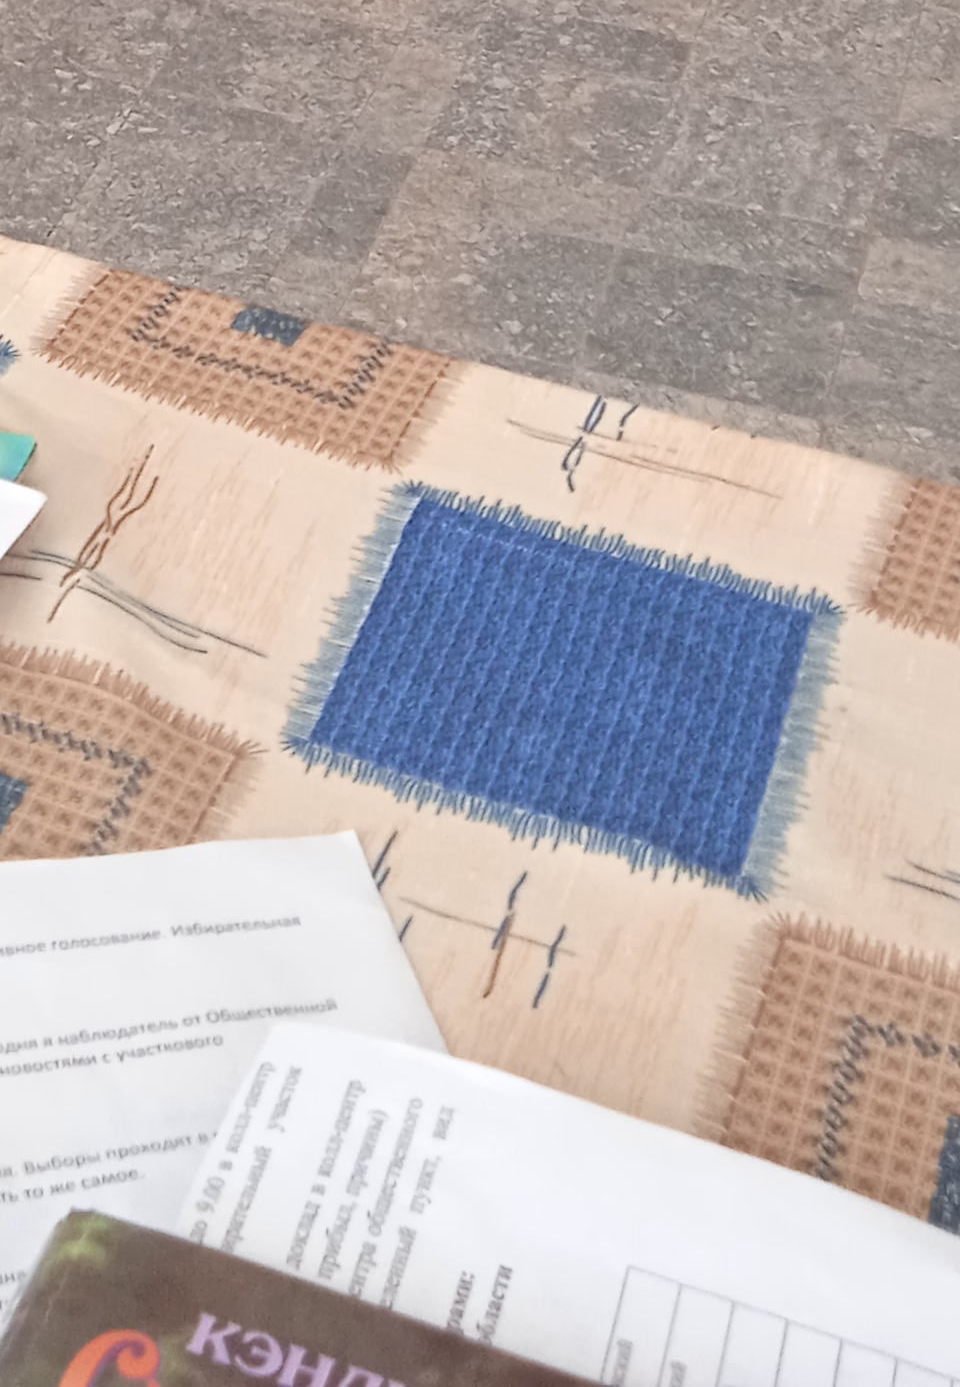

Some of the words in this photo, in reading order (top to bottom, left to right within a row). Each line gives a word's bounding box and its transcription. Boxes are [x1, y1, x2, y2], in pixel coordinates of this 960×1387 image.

[170, 916, 302, 937] Избирательная
[57, 1019, 179, 1046] наблюдатель
[204, 998, 338, 1025] Общественной
[115, 1035, 224, 1064] участкового
[22, 1152, 102, 1176] Выборы
[105, 1135, 192, 1161] проходят
